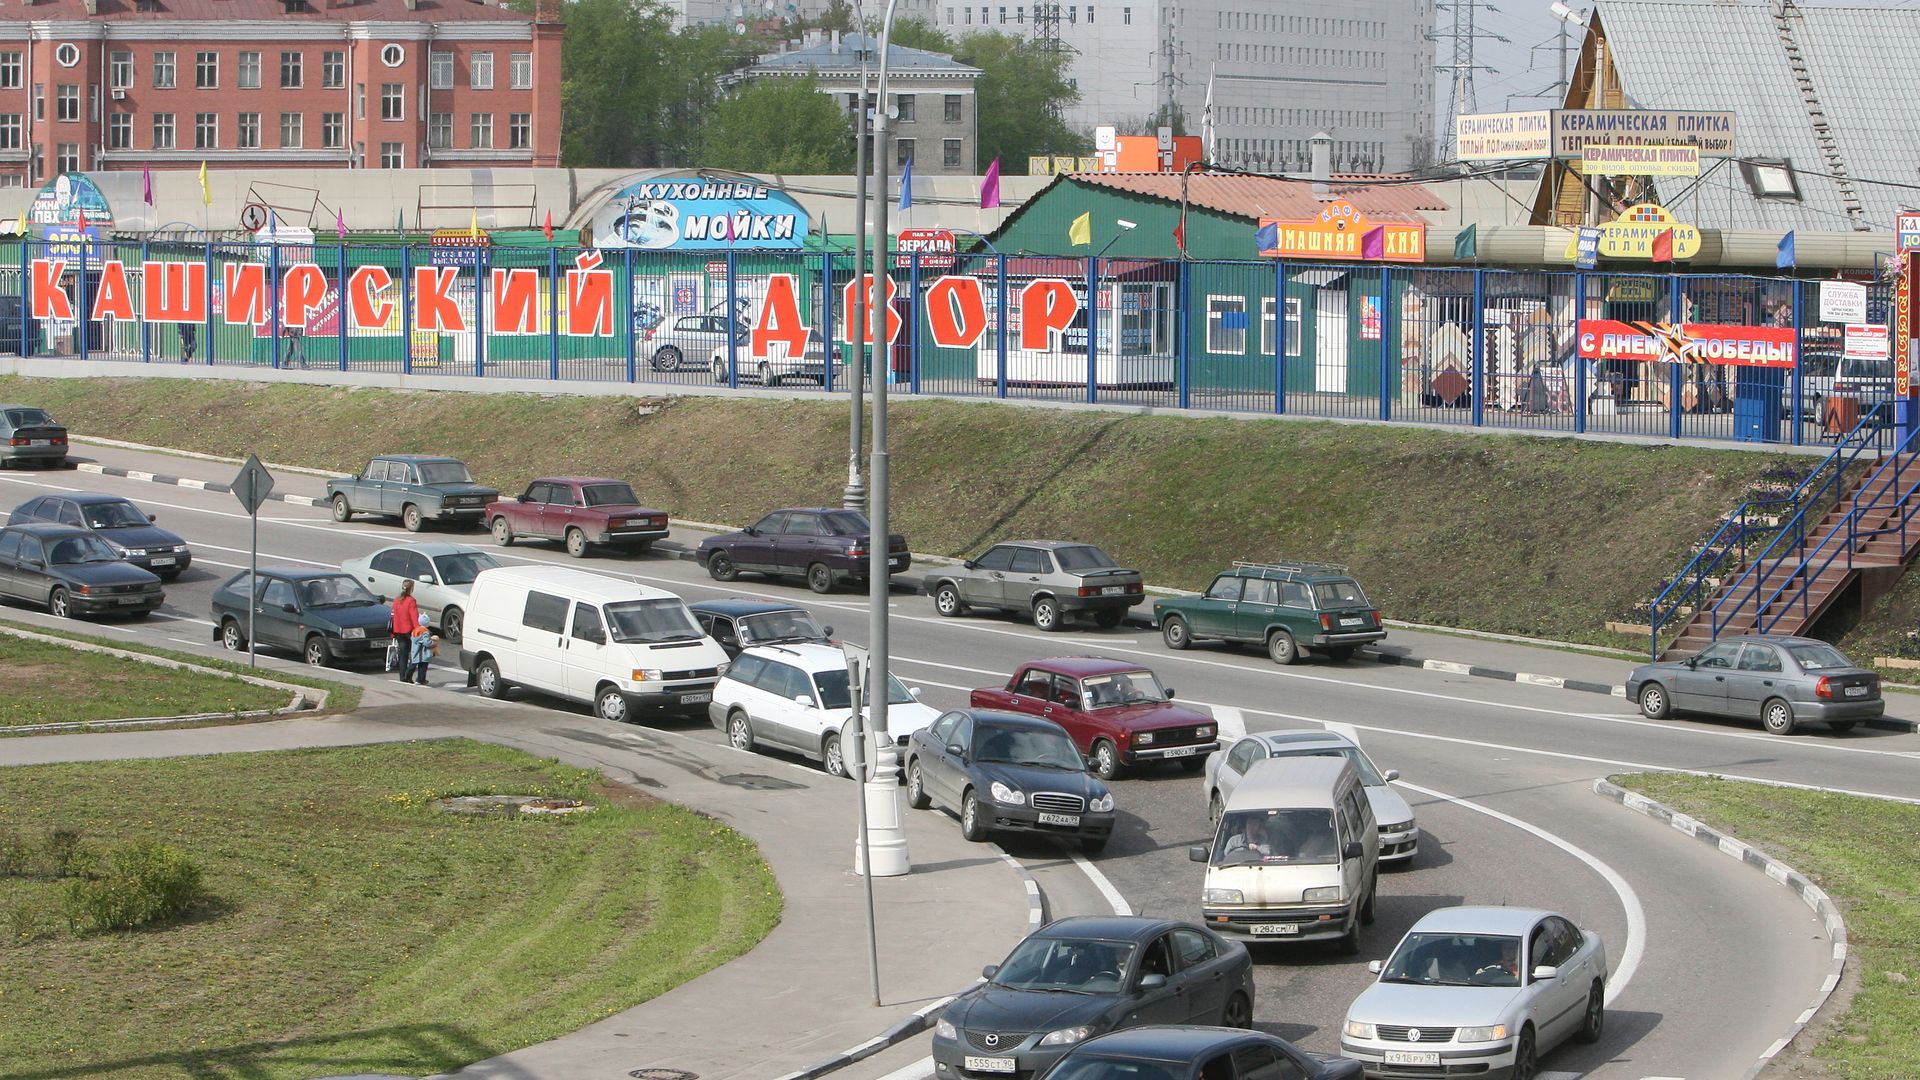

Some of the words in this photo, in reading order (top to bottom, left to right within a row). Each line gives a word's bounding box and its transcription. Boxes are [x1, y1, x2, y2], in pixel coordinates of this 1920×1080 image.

[1460, 118, 1514, 135] КЕРАМИЧЕСКАЯ
[1519, 115, 1548, 132] ПЛИТКА
[1561, 114, 1667, 131] КЕРАМИЧЕСКАЯ
[1677, 116, 1730, 131] ПЛИТКА
[1460, 137, 1484, 154] ТЕПЛЫЙ
[1486, 139, 1501, 153] ПОЛ
[1705, 139, 1728, 150] ВЫБОР
[1583, 148, 1657, 161] КЕРАМИЧЕСКАЯ
[1659, 150, 1697, 162] ПЛИТКА
[639, 183, 769, 200] КУХОННЫЕ
[35, 200, 60, 210] ОКНА
[34, 210, 60, 224] ПВХ
[1321, 204, 1361, 224] КАФЕ
[684, 210, 795, 241] МОЙКИ
[1601, 227, 1693, 239] КЕРАМИЧКАЯ
[900, 239, 951, 252] ЗЕРКАЛА
[1277, 227, 1355, 252] ОМАШНЯЯ
[1386, 230, 1419, 254] ХНЯ
[1609, 240, 1685, 252] ПЛИА
[1827, 290, 1859, 299] СЛУЖБА
[31, 249, 614, 338] КАШИРСКИЙ
[751, 272, 1078, 360] ДВОР
[1823, 299, 1863, 308] ДОСТАВКИ
[1580, 333, 1595, 352] С
[1600, 333, 1662, 356] ДНЕМ
[1692, 337, 1793, 364] ПОБЕДЫ!
